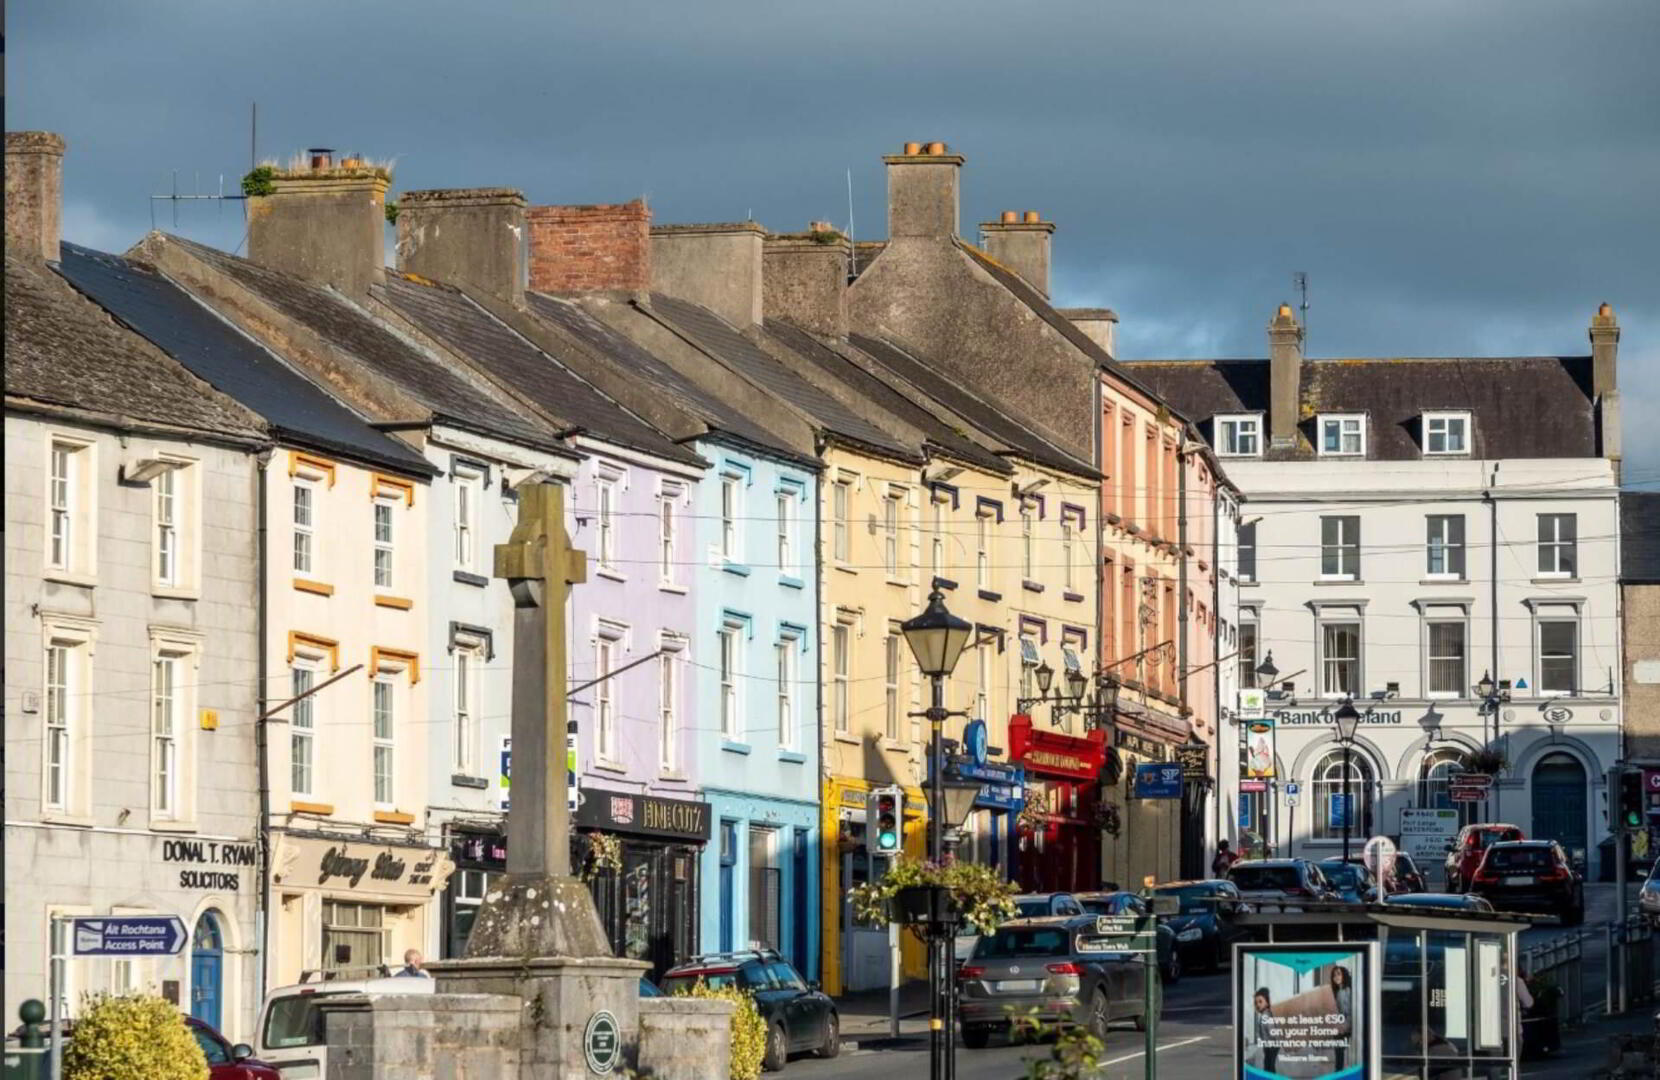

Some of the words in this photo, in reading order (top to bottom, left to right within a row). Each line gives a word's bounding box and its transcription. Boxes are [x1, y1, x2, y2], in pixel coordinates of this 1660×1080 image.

[1281, 711, 1320, 724] Bank
[163, 840, 207, 863] DONAL
[208, 843, 219, 863] T.
[222, 844, 255, 866] RYAN
[180, 870, 239, 891] SOLICITORS
[121, 924, 166, 935] Rochtana
[104, 940, 137, 950] Access
[139, 940, 165, 950] Point
[1261, 1015, 1286, 1025] Save
[1287, 1016, 1298, 1025] at
[1299, 1014, 1323, 1025] least
[1325, 1014, 1345, 1025] €50
[1270, 1028, 1283, 1036] on
[1285, 1028, 1309, 1038] your
[1310, 1026, 1338, 1036] Home
[1257, 1038, 1307, 1048] Insurance
